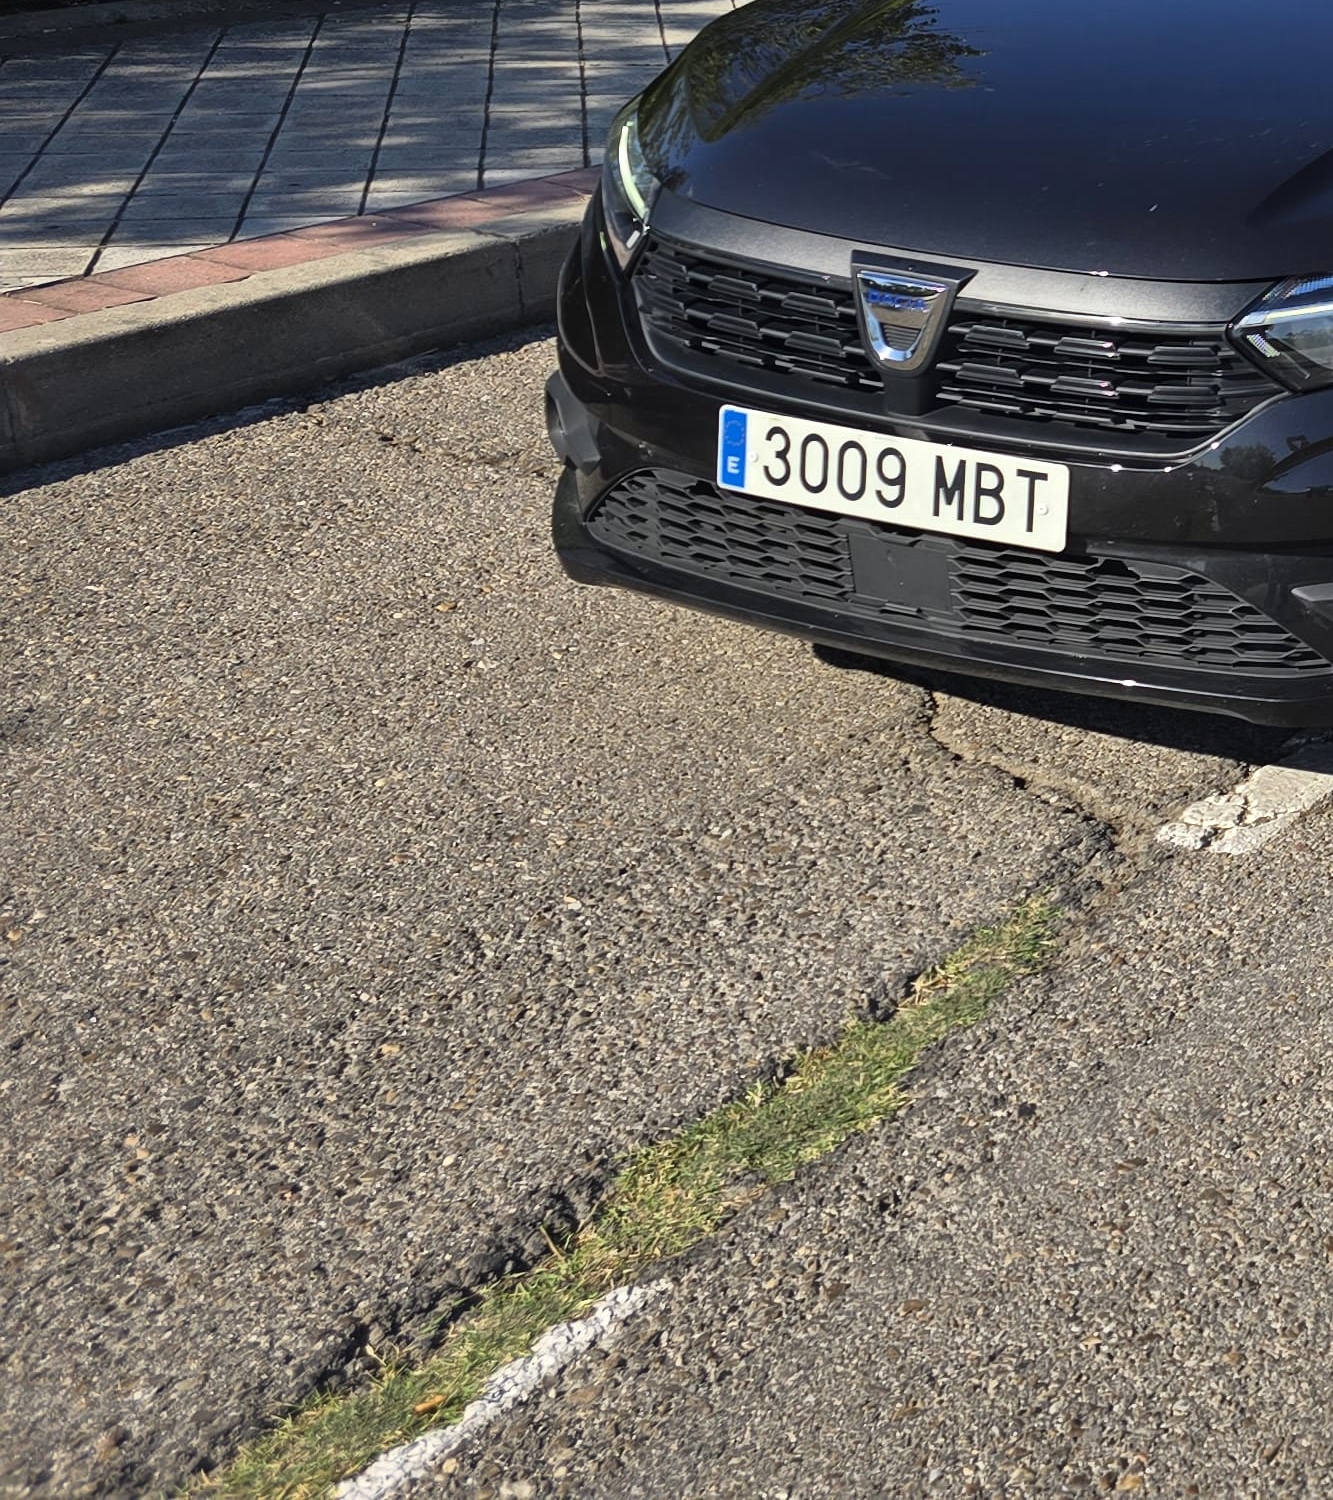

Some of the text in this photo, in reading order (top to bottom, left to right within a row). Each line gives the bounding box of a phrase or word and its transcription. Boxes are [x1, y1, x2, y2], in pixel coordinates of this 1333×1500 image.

[867, 288, 929, 312] DACIA
[727, 456, 741, 475] E
[762, 425, 1049, 533] 3009 MBT
